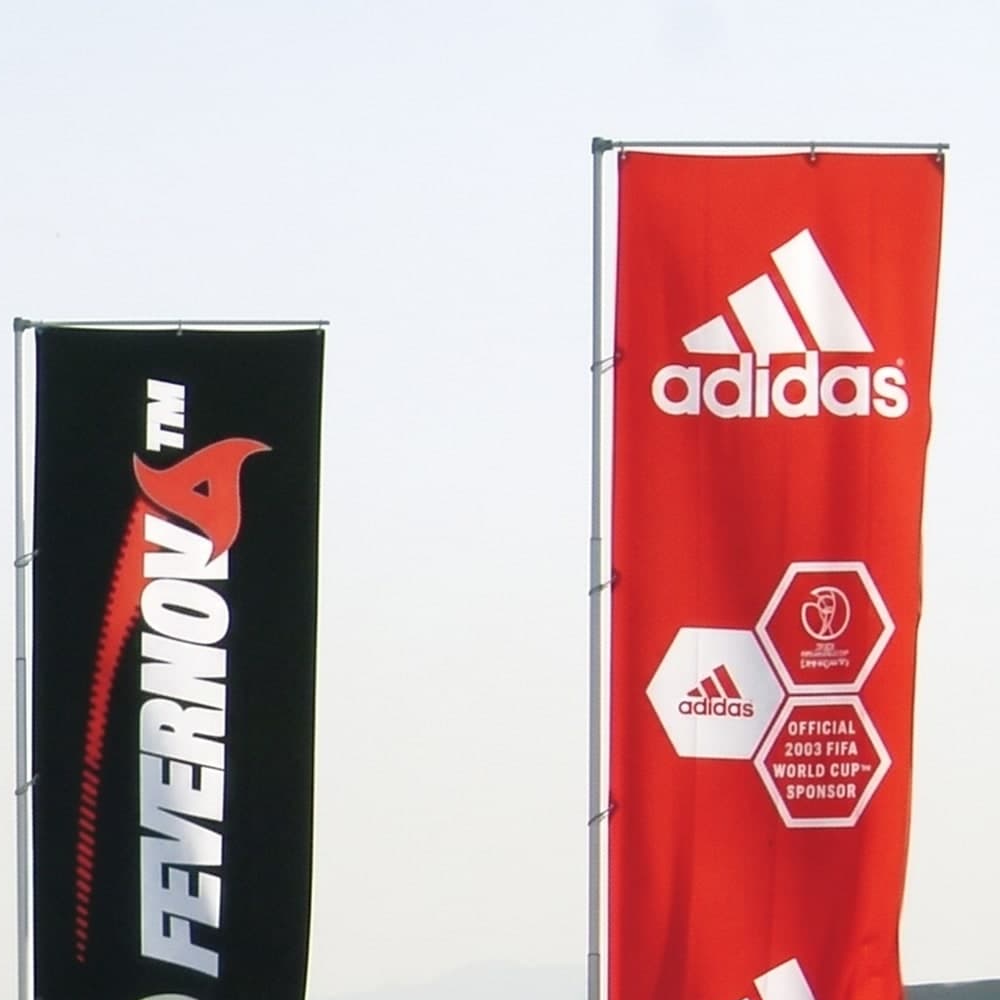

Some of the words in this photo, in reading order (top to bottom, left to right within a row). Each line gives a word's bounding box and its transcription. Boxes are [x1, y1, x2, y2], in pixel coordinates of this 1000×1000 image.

[652, 350, 908, 419] adidas
[133, 437, 273, 978] FEVERNOVA
[679, 697, 754, 718] adidas
[787, 720, 856, 736] OFFICIAL
[826, 741, 858, 756] FIFA
[773, 763, 826, 778] WORLD
[786, 783, 857, 799] SPONSOR
